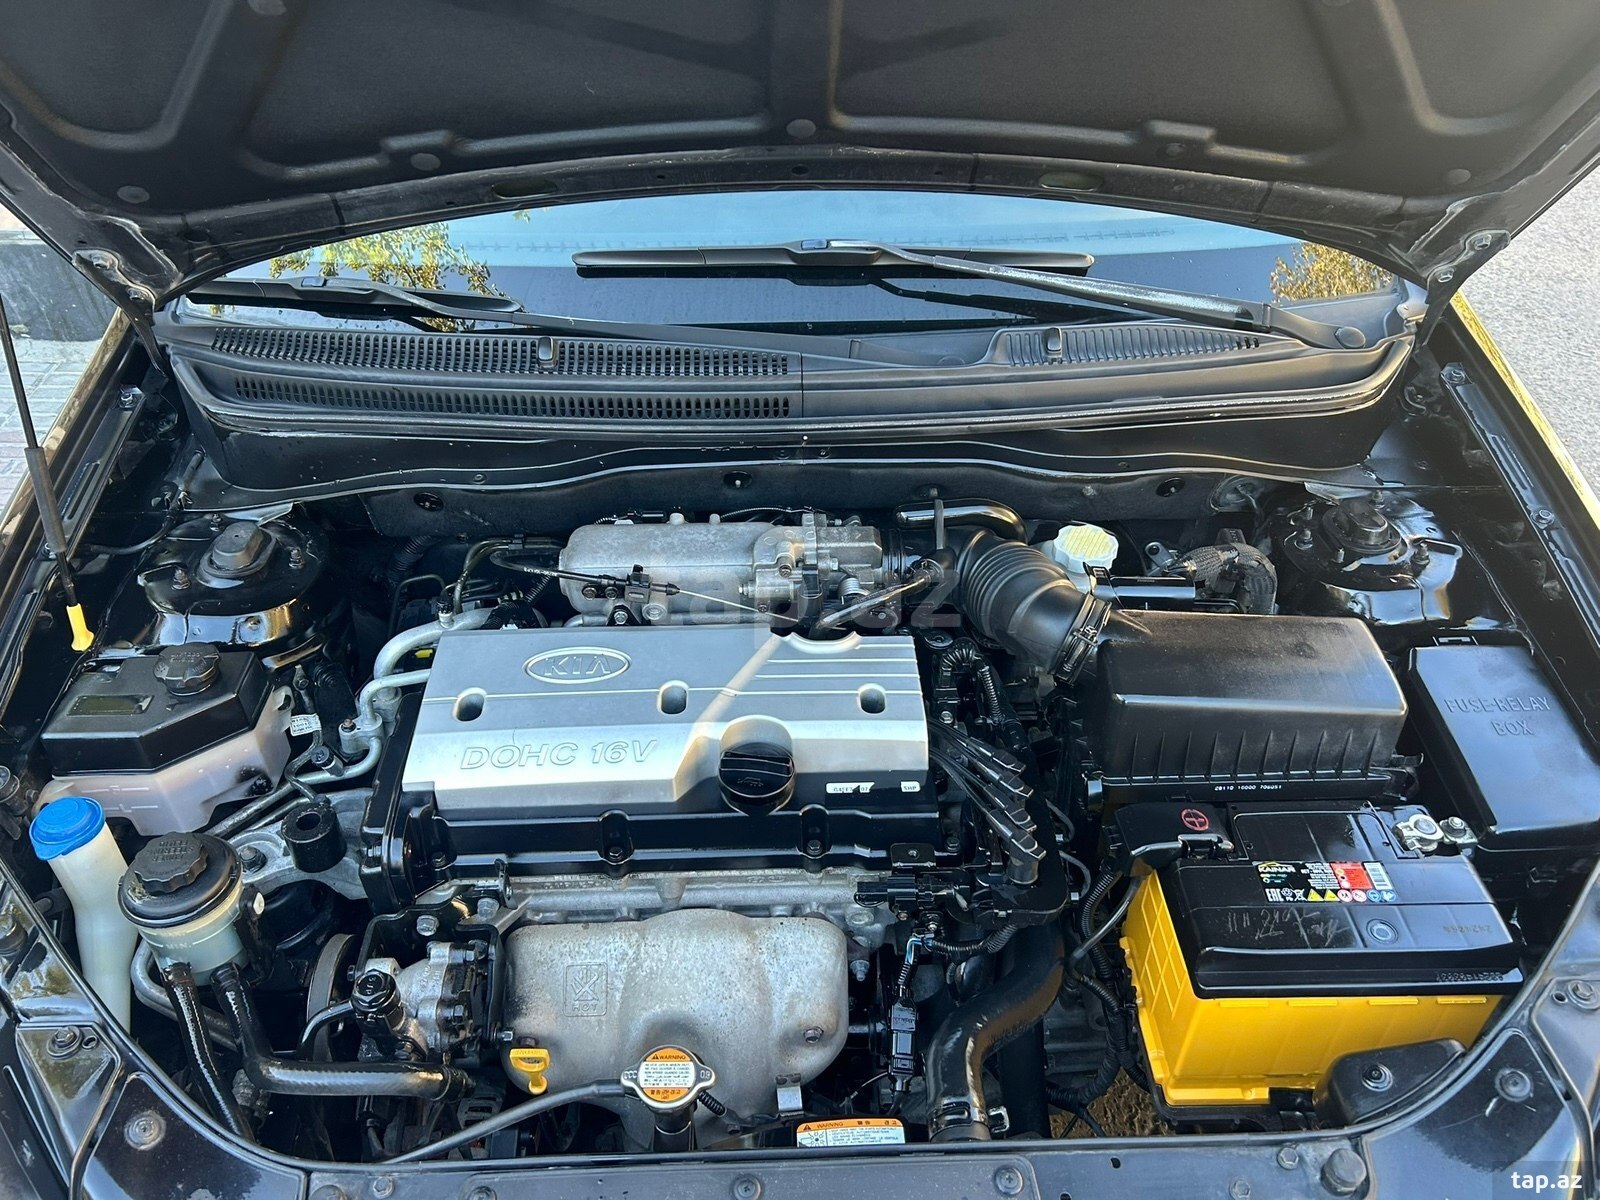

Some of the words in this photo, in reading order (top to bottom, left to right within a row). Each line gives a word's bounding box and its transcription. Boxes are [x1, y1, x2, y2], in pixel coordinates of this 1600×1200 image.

[543, 656, 611, 676] KIA
[1443, 696, 1550, 714] FUSE-RELAY
[1491, 720, 1535, 736] BOX
[460, 742, 579, 770] DOHC
[591, 739, 658, 764] 16V
[572, 1003, 598, 1012] HOT
[816, 1121, 844, 1129] WARNING
